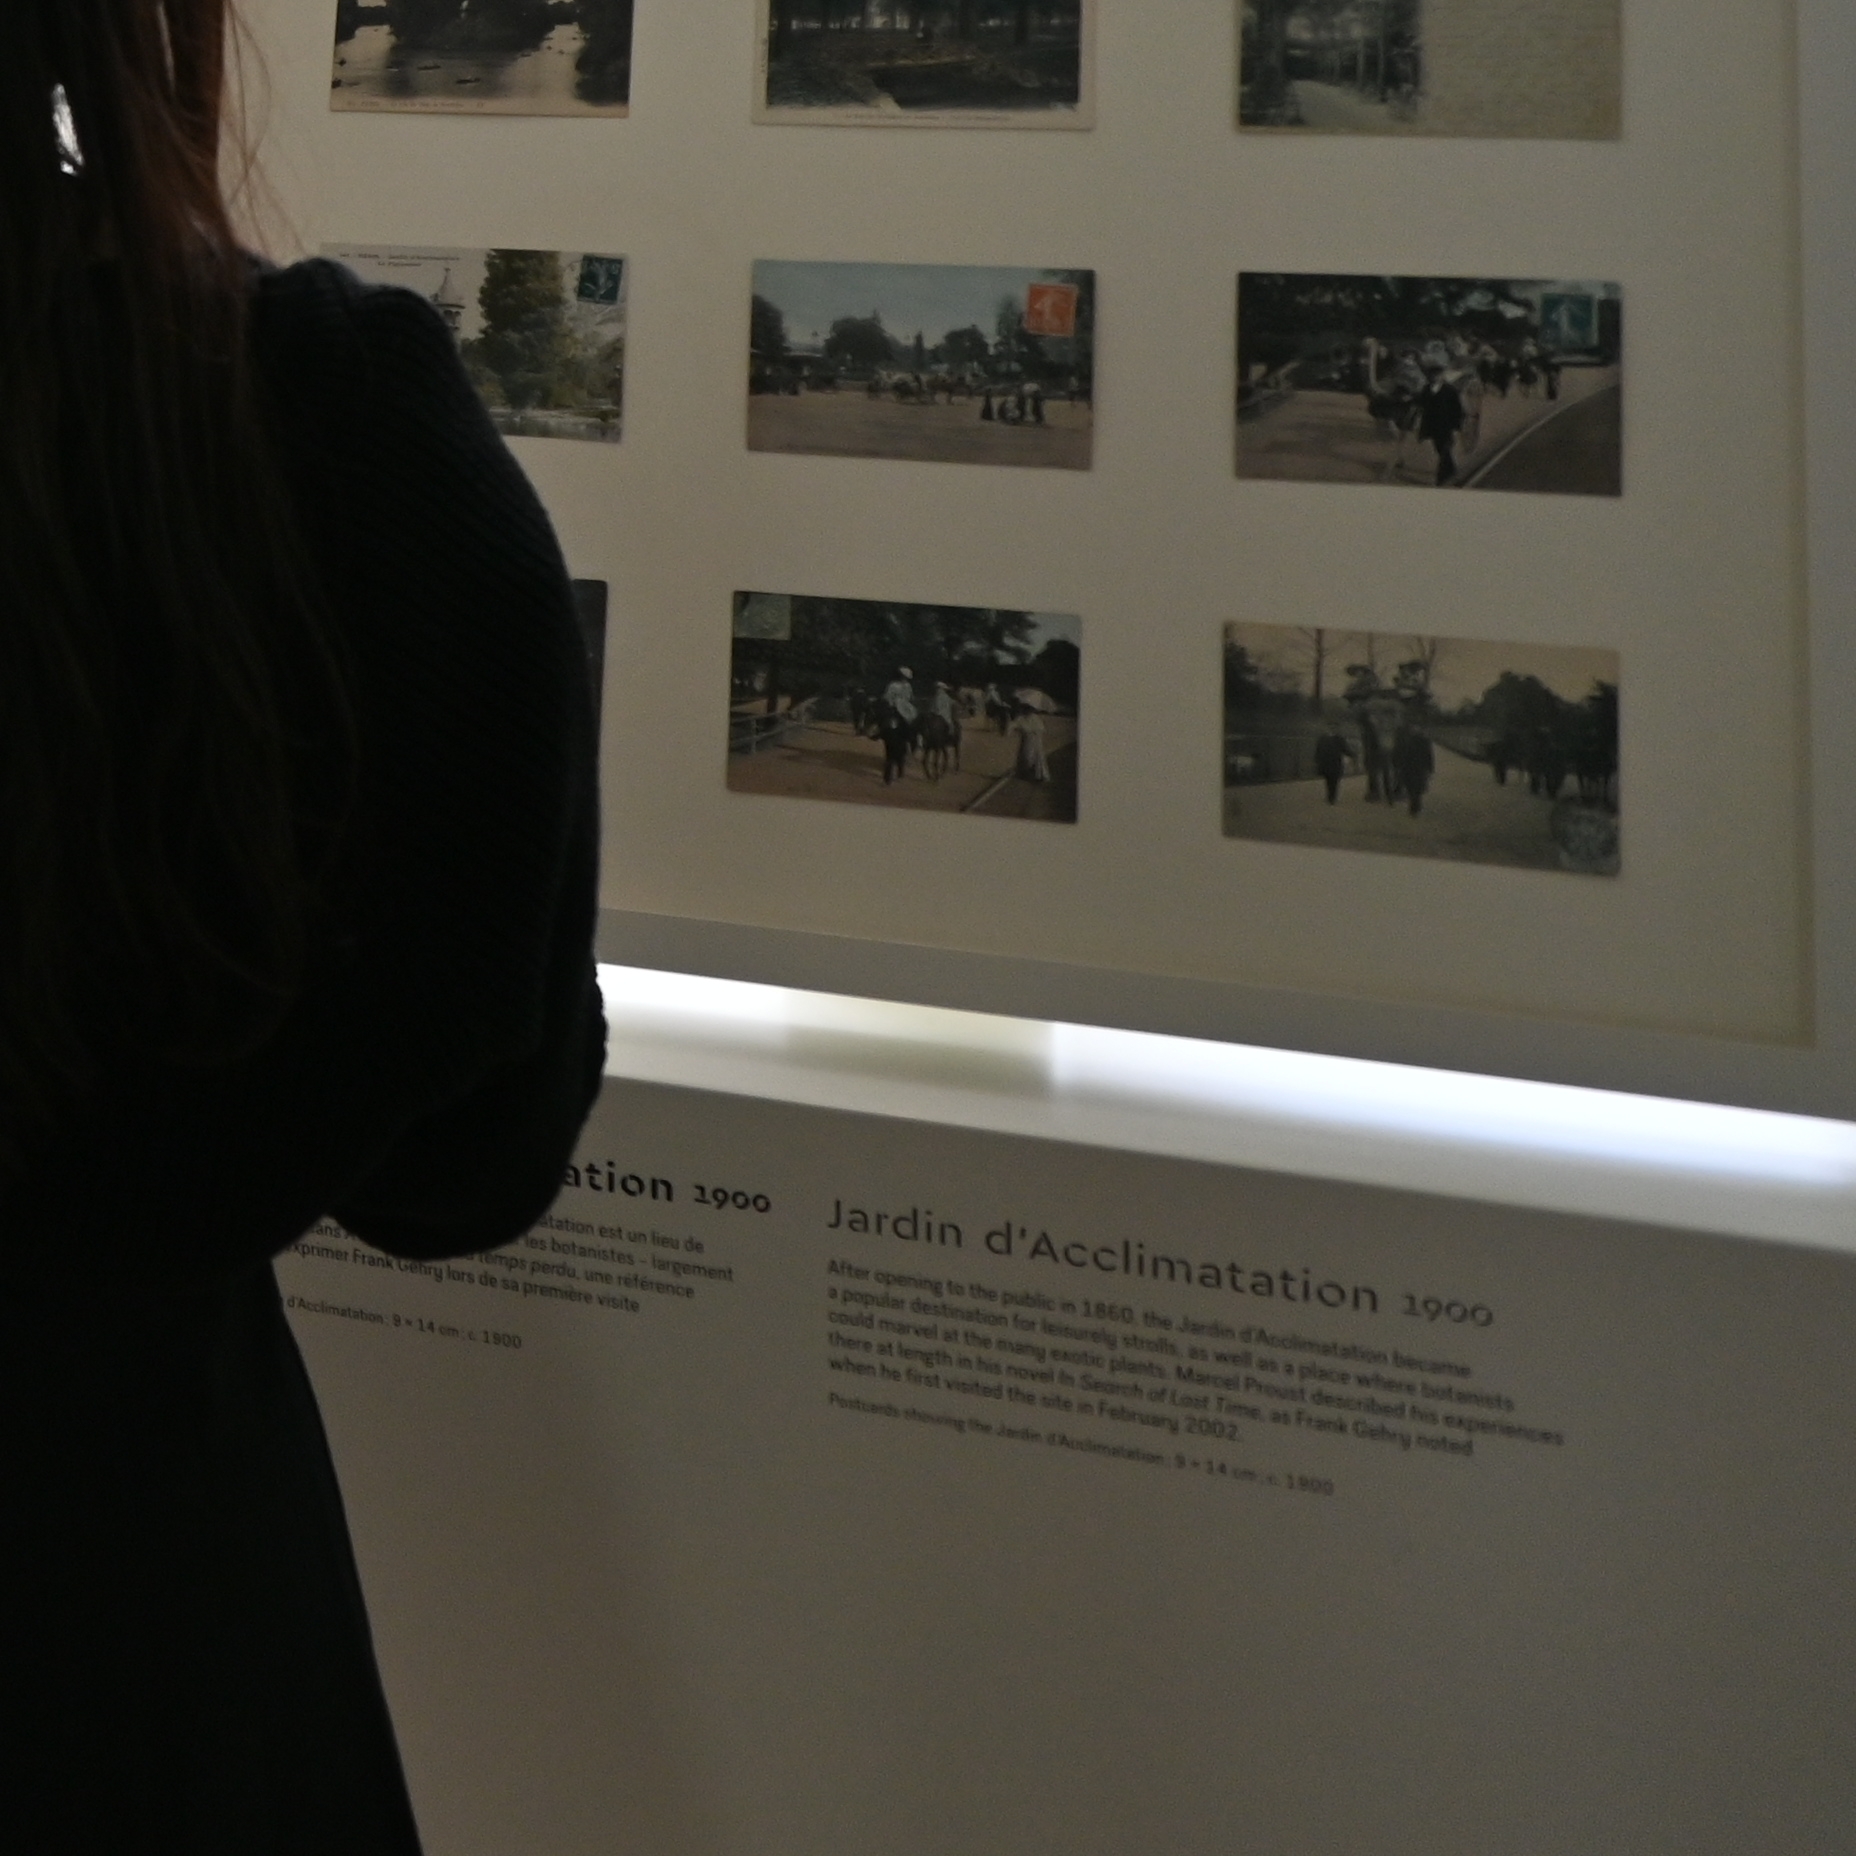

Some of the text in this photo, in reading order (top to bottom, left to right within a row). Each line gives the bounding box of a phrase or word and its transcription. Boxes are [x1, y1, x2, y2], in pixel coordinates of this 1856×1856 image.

[564, 1161, 771, 1213] ation 1900
[526, 1231, 734, 1282] les botanistes largement
[599, 1225, 704, 1253] est un lieu de
[828, 1199, 1494, 1327] Jardin d'Acclimatation 1900
[292, 1241, 640, 1313] xprimer Frank Gehry lors de sa première visite
[479, 1246, 524, 1270] temps
[584, 1269, 613, 1285] une
[617, 1273, 695, 1298] référence
[287, 1295, 522, 1349] d'Acclimatation 14 1900
